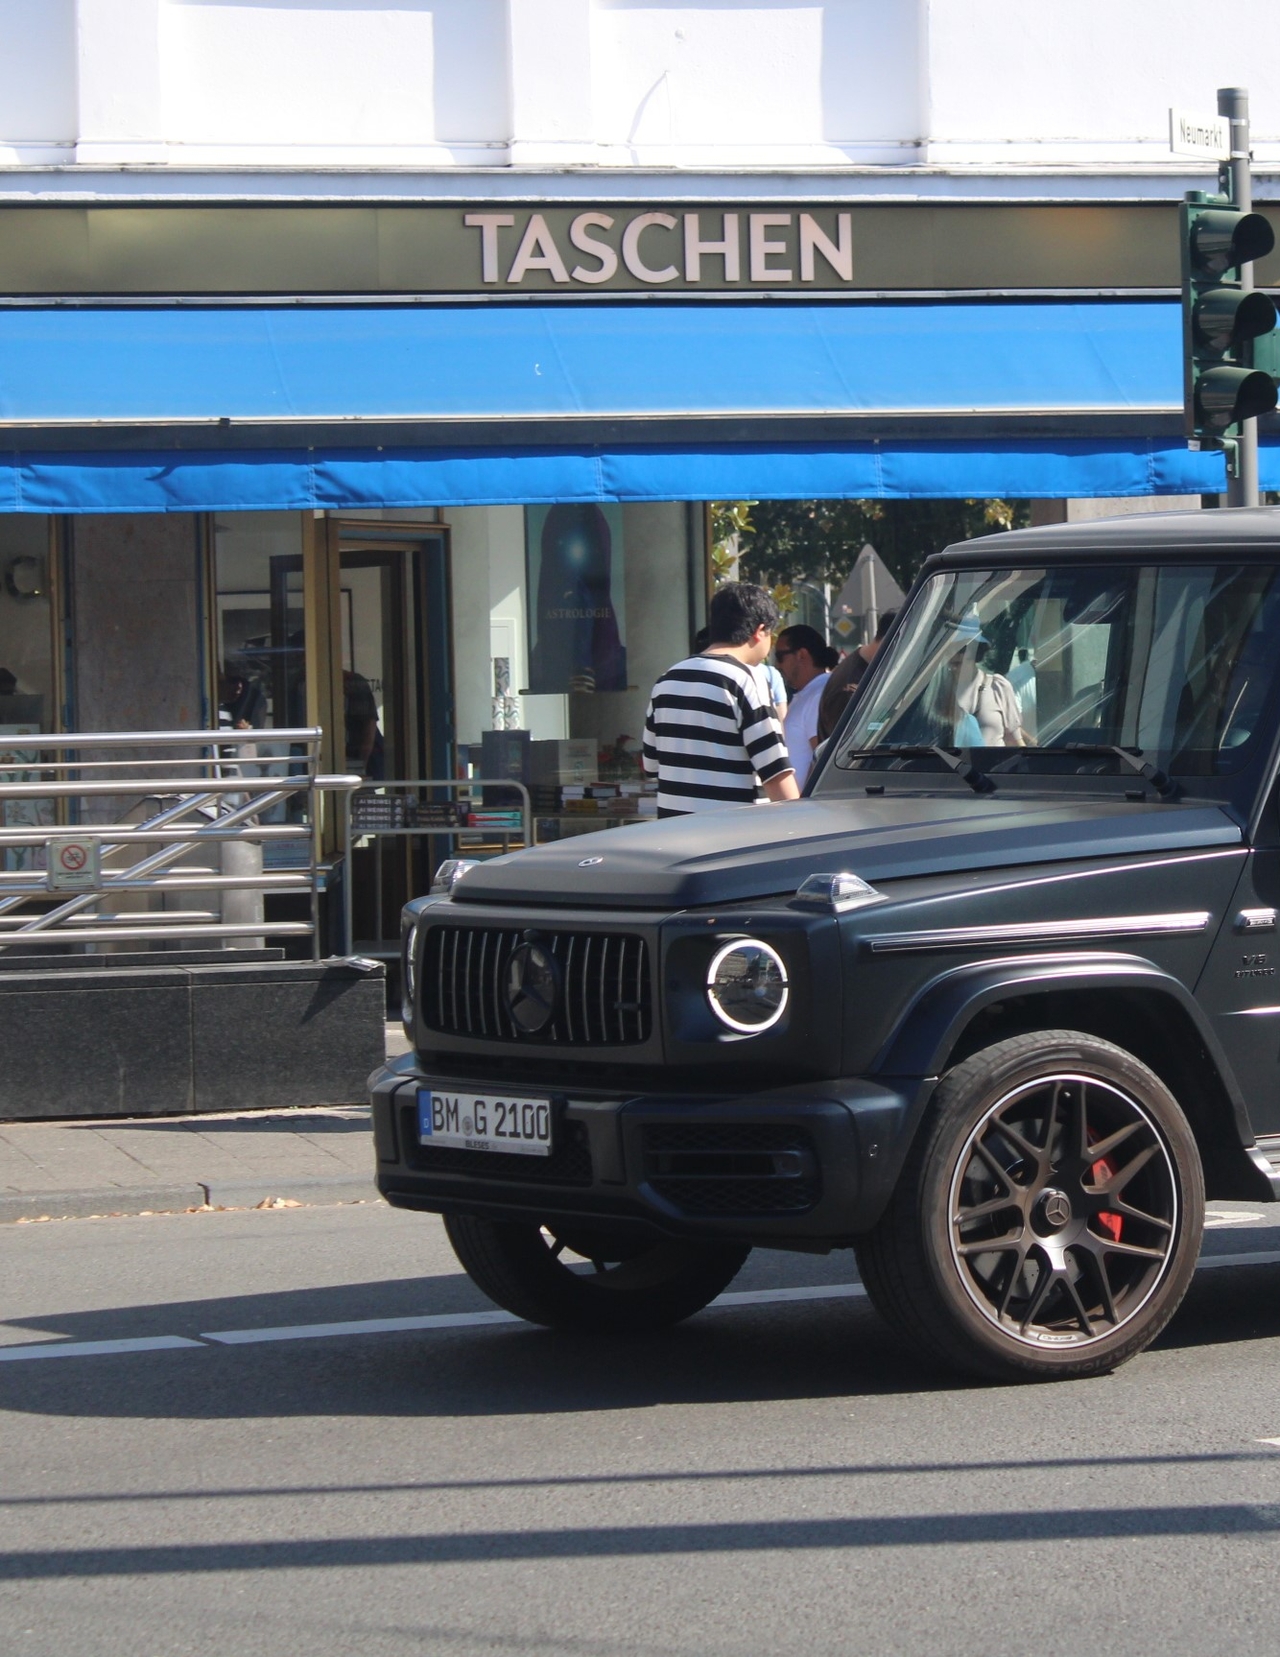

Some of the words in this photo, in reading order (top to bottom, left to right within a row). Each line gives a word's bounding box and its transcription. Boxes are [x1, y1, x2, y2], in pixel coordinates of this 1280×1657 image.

[1180, 117, 1223, 149] Neumarkt
[464, 211, 853, 284] TASCHEN
[546, 608, 610, 618] ASTROLOGIE
[432, 1096, 459, 1133] BM
[474, 1100, 487, 1135] G
[494, 1102, 549, 1140] 2100
